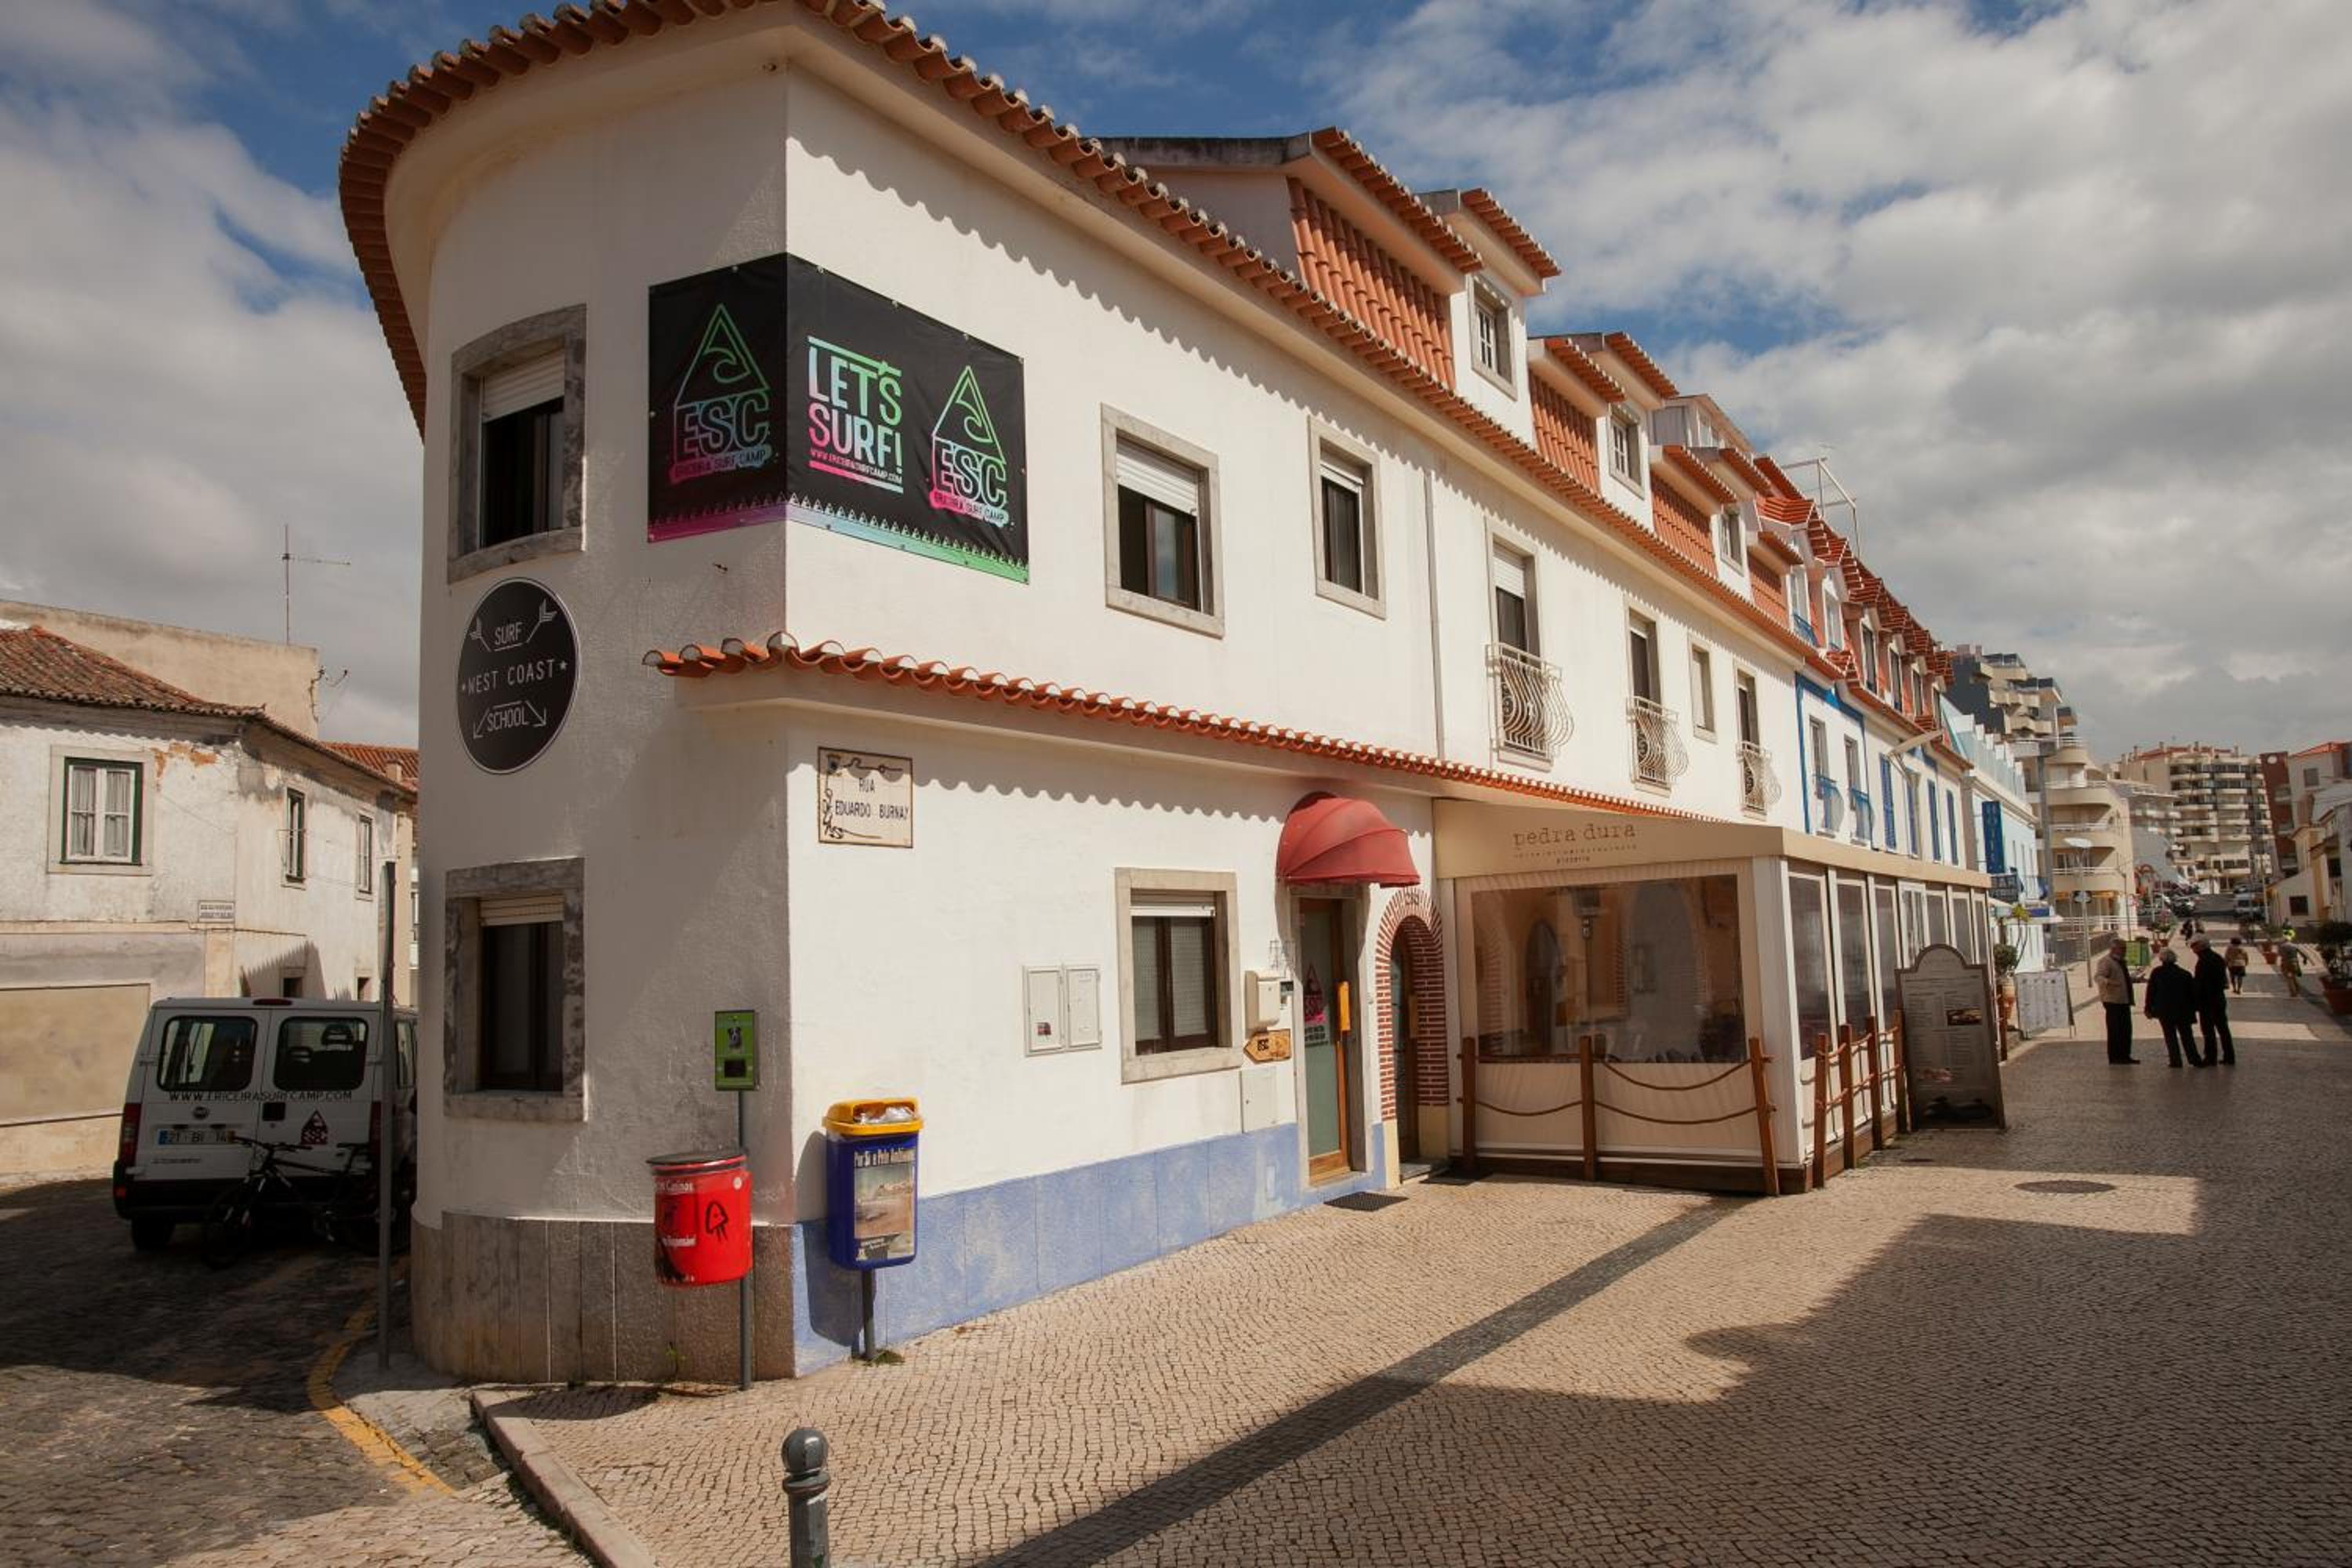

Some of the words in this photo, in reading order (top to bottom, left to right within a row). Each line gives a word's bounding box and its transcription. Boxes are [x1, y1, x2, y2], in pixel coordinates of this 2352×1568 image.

[808, 346, 902, 426] LET'S
[675, 390, 770, 462] ESC
[808, 401, 902, 473] SURF!
[739, 449, 766, 464] CAMP
[931, 437, 1008, 507] ESC
[984, 506, 1005, 521] CAMP
[495, 622, 524, 645] SURF
[507, 659, 554, 686] COAST
[487, 707, 530, 732] SCHOOL
[858, 778, 876, 793] RUA
[835, 800, 871, 818] EDUARDO
[879, 804, 909, 821] BURNAY
[1513, 827, 1576, 851] pedra
[1583, 823, 1635, 841] dura
